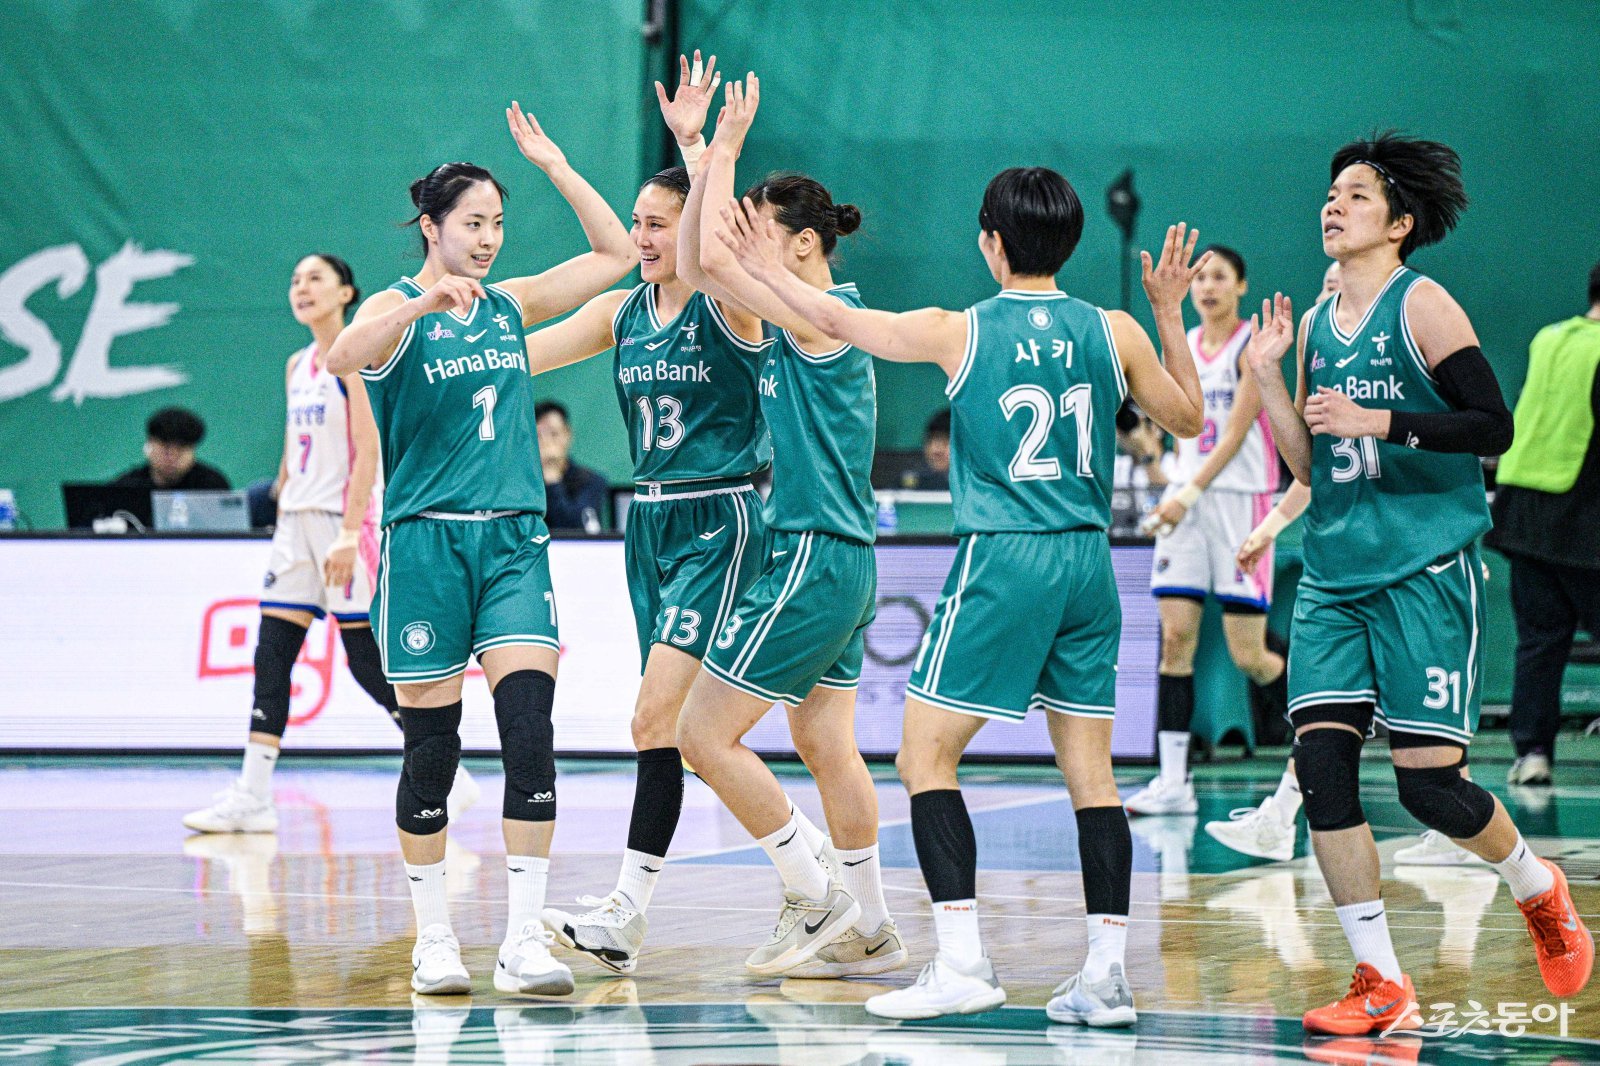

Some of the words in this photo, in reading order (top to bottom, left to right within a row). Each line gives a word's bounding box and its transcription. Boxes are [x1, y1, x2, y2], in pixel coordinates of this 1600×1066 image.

[423, 358, 485, 384] Hana
[484, 348, 527, 374] Bank
[656, 360, 712, 382] Bank
[1015, 338, 1073, 369] 사키
[759, 374, 779, 398] nk
[1346, 374, 1405, 400] Bank
[472, 385, 497, 441] 1
[637, 395, 685, 451] 13
[998, 383, 1094, 482] 21
[299, 432, 311, 474] 7
[1331, 434, 1381, 482] 31
[544, 591, 557, 627] 1
[661, 606, 702, 647] 13
[716, 615, 742, 649] 3
[1422, 666, 1461, 714] 31
